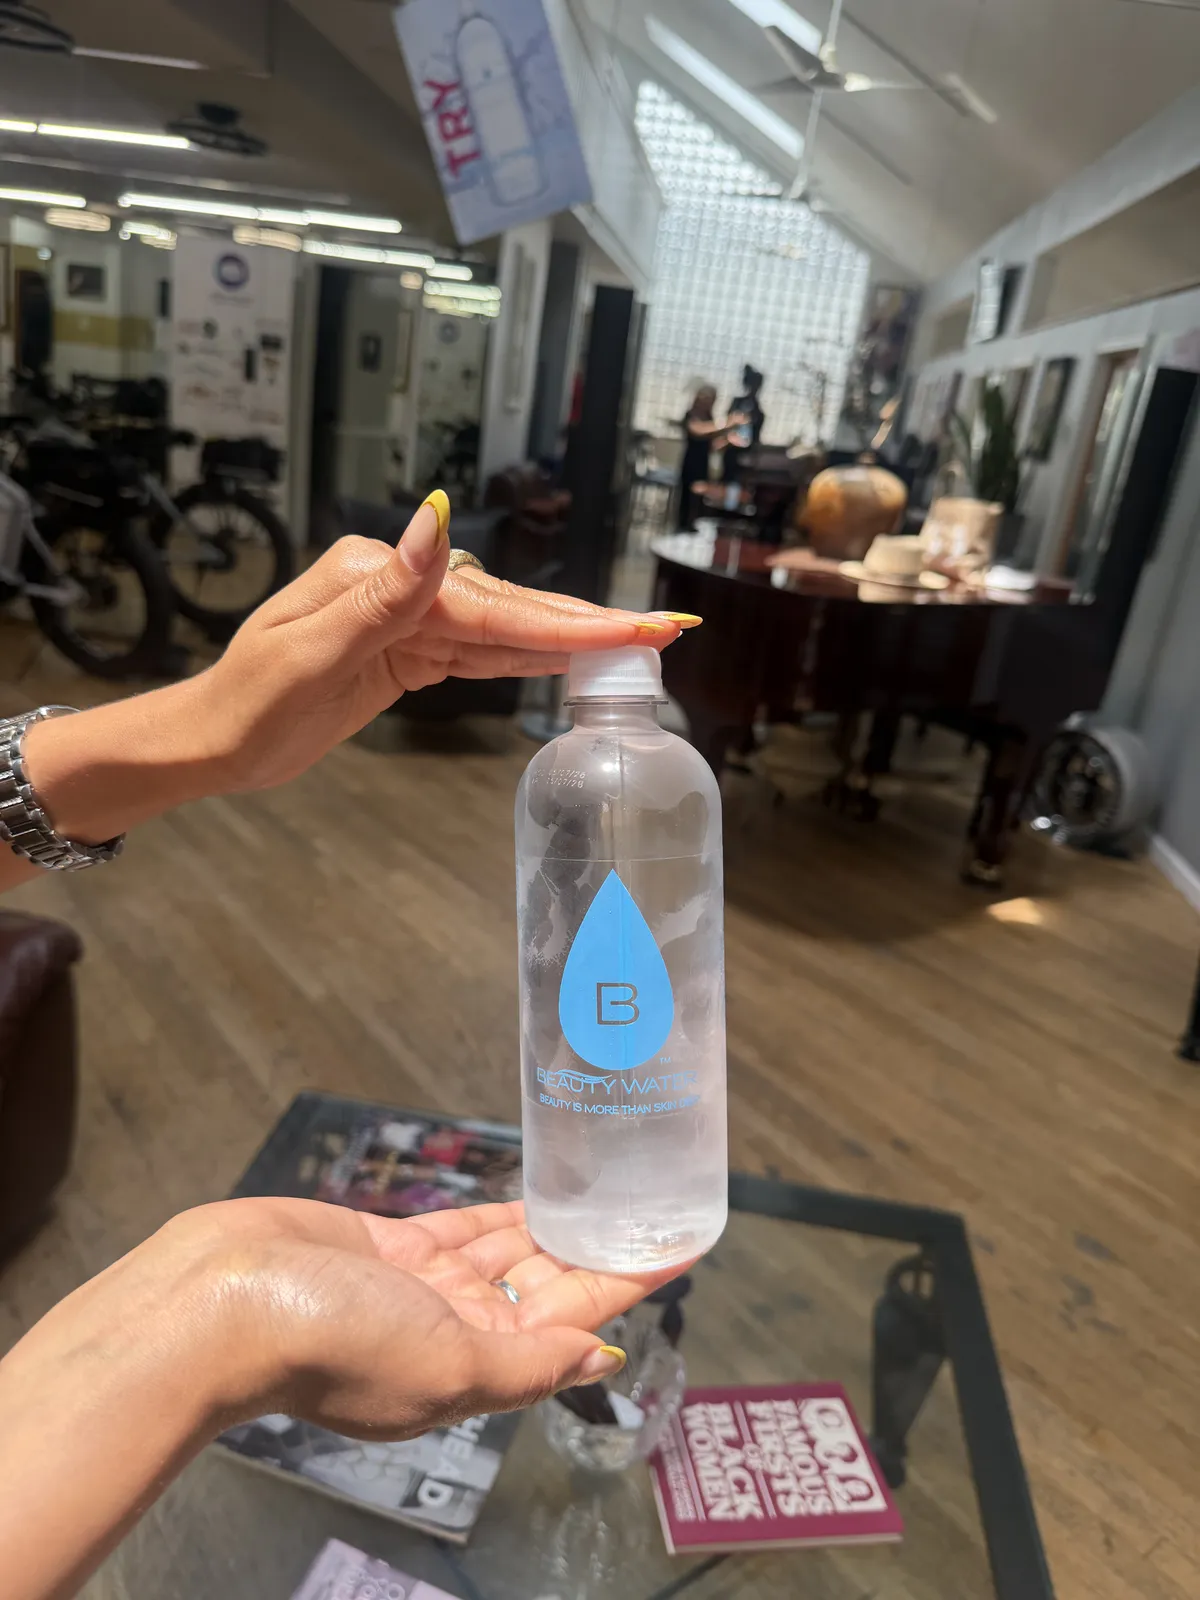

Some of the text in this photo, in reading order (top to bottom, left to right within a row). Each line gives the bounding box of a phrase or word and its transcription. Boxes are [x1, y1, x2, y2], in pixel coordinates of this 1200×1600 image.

[422, 78, 481, 180] TRY
[596, 982, 640, 1026] B
[536, 1066, 698, 1095] BEAUTY WATER
[540, 1092, 571, 1110] BEAUTY
[572, 1101, 582, 1113] IS
[584, 1103, 619, 1115] MORE
[621, 1103, 651, 1115] THAN
[654, 1100, 676, 1113] SKIN
[680, 1402, 737, 1521] WOMEN
[706, 1402, 765, 1521] BLACK
